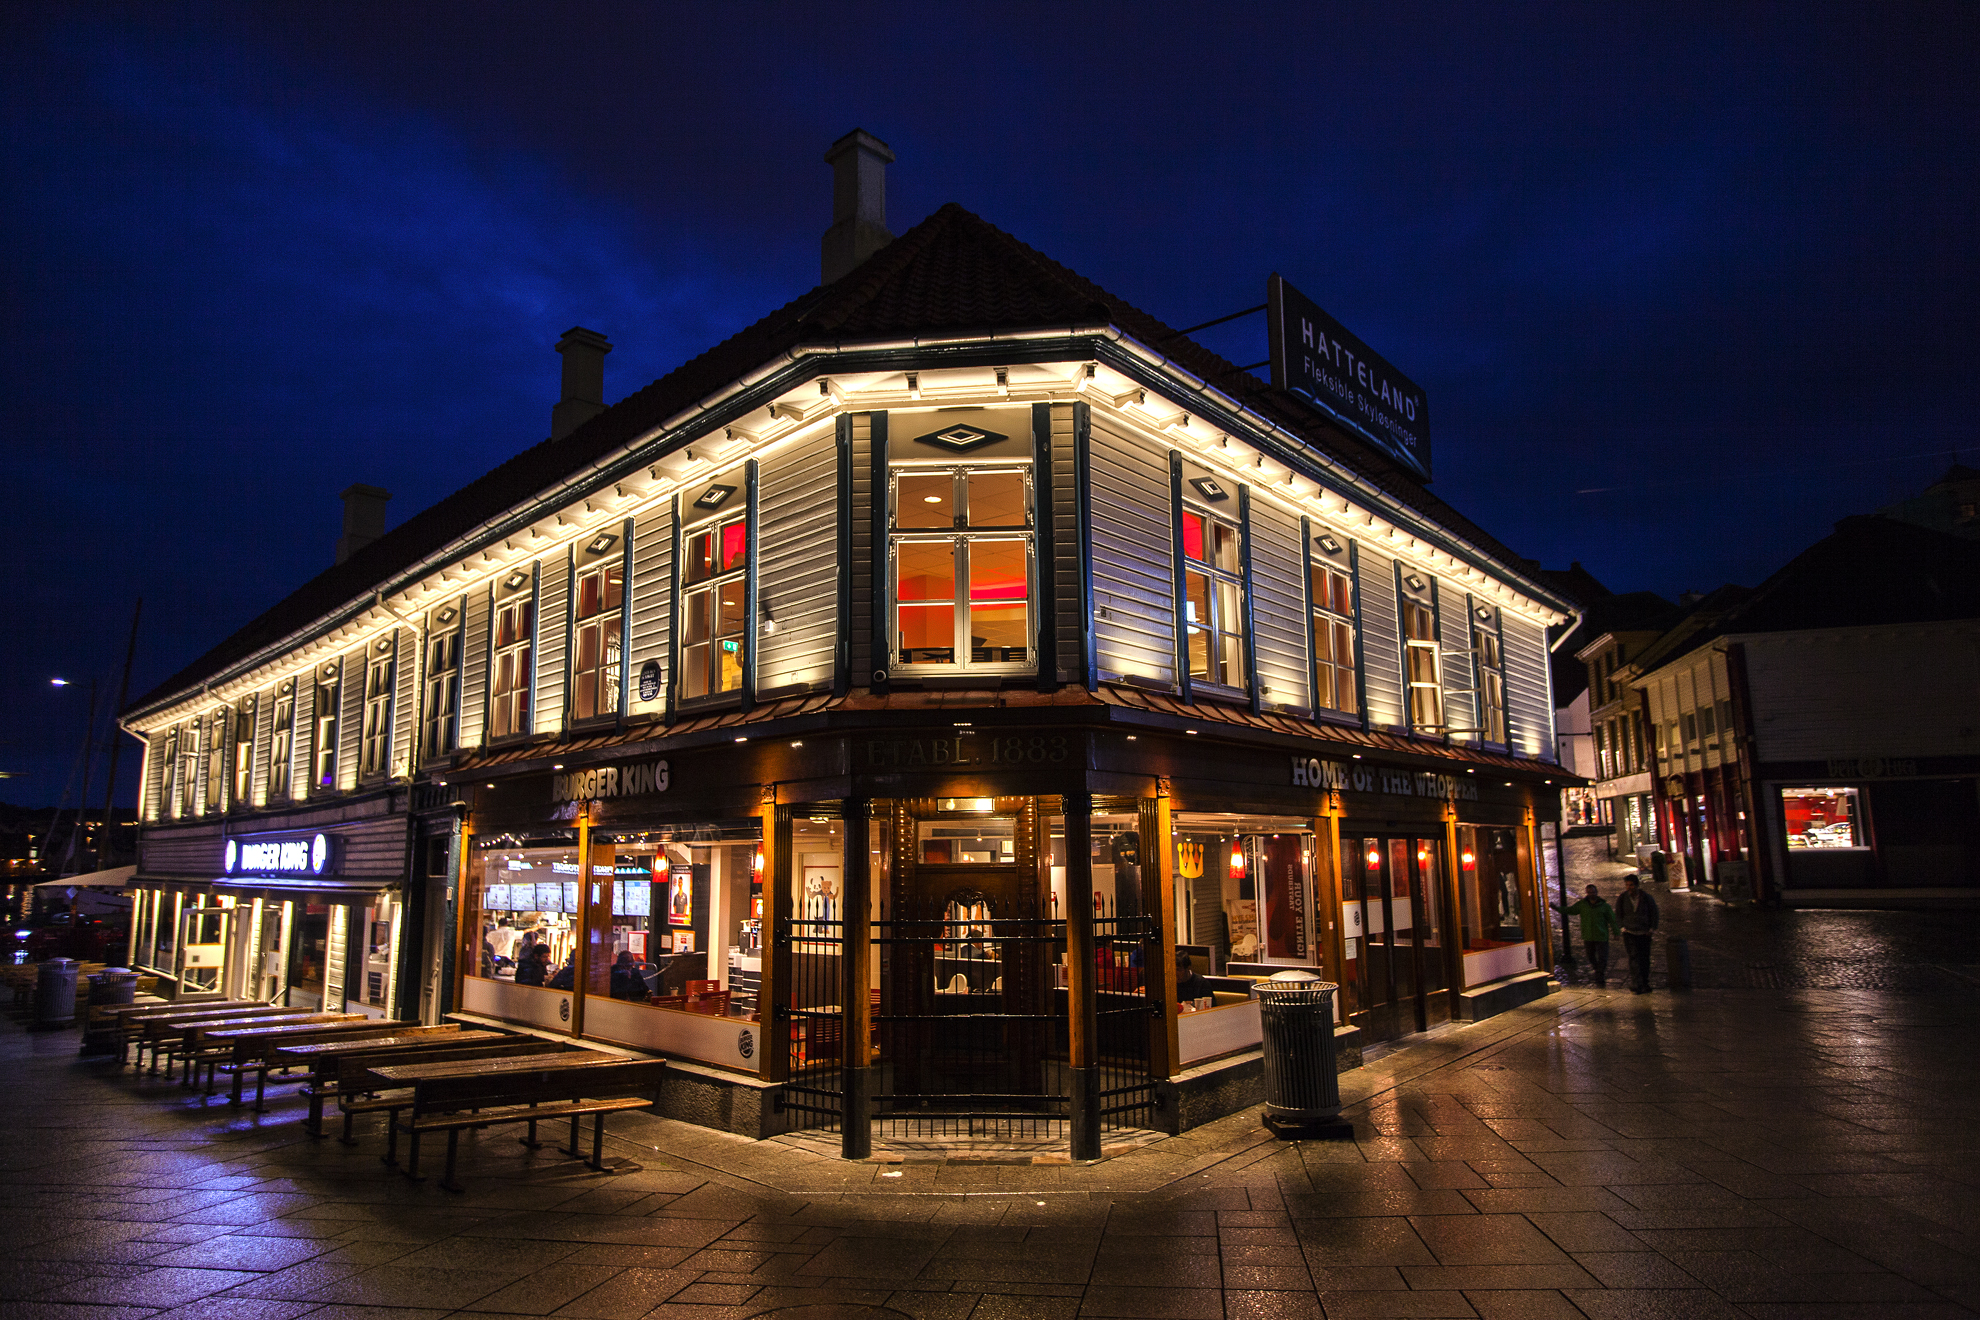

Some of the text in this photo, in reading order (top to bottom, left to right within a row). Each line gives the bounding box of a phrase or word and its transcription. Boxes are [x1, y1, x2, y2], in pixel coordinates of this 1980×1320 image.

[1301, 317, 1416, 422] HATTELAND
[1304, 355, 1417, 448] Fleksible Skyløsninger
[867, 736, 1069, 766] ETABL. 1883
[552, 759, 669, 802] BURGER KING
[1291, 756, 1479, 802] HOME OF THE WHOPPER
[240, 842, 281, 871] BURGER
[280, 840, 309, 871] KING
